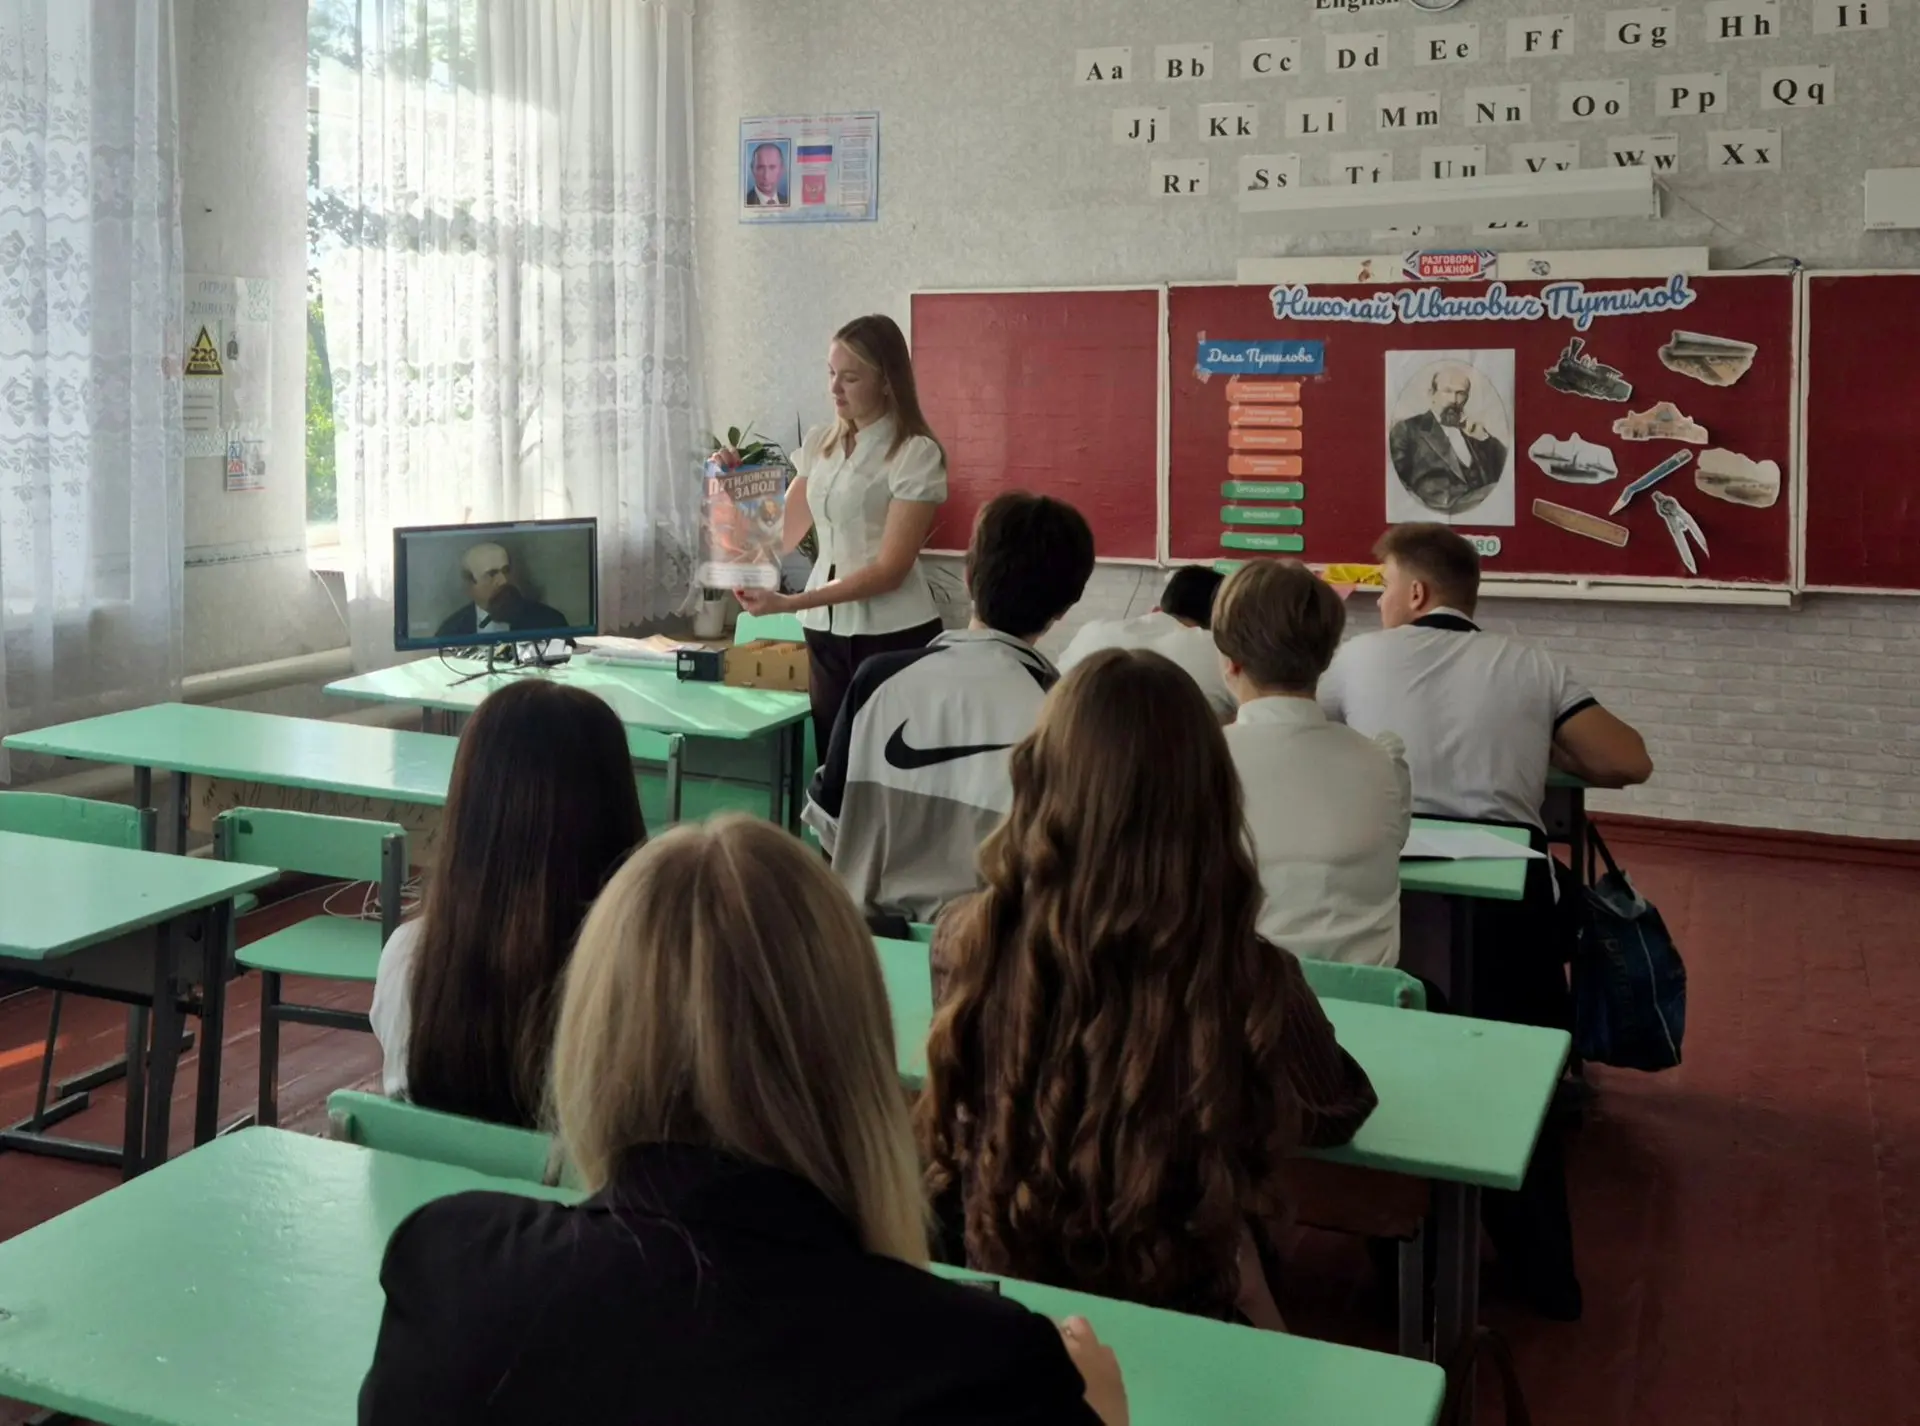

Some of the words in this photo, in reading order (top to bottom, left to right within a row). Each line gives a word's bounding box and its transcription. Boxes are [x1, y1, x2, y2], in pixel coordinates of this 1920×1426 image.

[1421, 255, 1477, 265] РАЗГОВОРЫ
[1432, 264, 1474, 275] ВАЖНОМ
[1272, 288, 1393, 320] Николай
[1398, 285, 1539, 318] Иванович
[1545, 274, 1690, 329] Путилов
[190, 347, 218, 362] 220
[1246, 347, 1315, 369] Путилова
[734, 480, 777, 500] ЗАВОД
